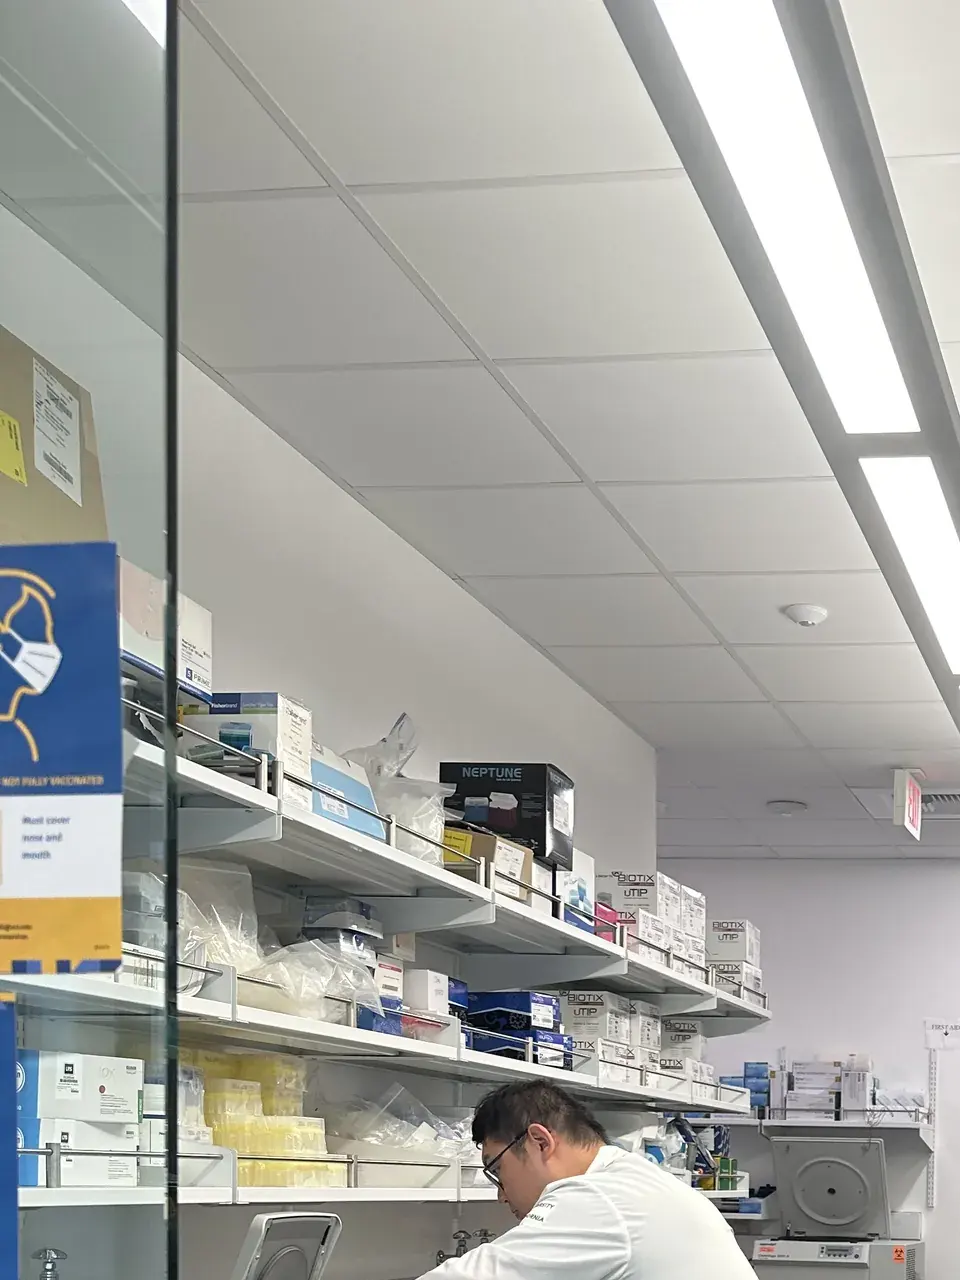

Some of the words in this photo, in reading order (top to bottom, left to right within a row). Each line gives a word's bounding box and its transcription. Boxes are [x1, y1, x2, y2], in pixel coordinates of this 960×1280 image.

[462, 767, 522, 778] NEPTUNE
[50, 774, 104, 786] VACCINATED
[618, 874, 655, 882] BIOTIX
[568, 994, 604, 1002] BIOTIX
